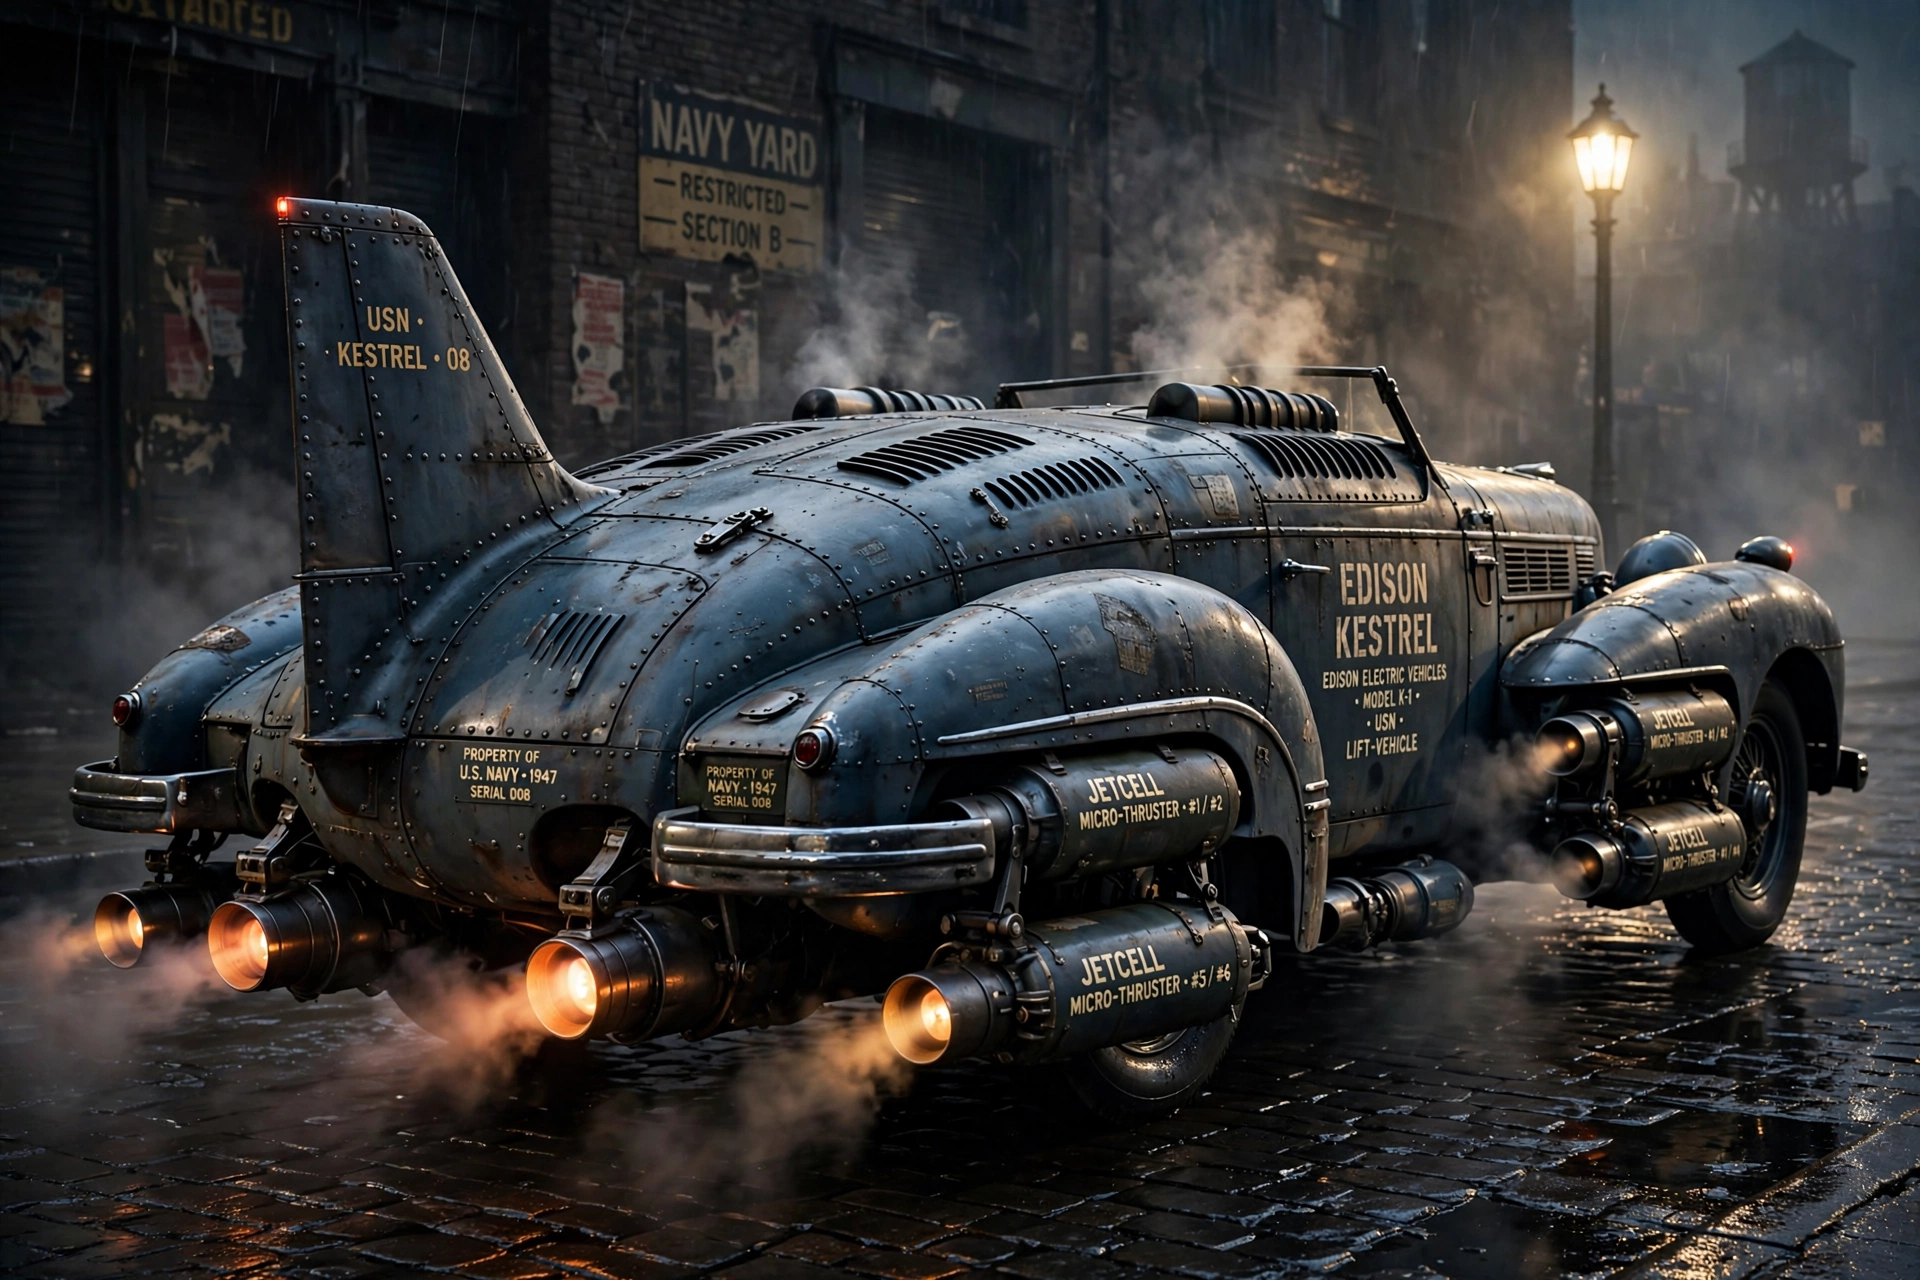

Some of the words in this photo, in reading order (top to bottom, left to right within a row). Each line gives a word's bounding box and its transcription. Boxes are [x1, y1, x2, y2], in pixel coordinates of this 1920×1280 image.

[651, 99, 735, 163] NAVY
[744, 119, 817, 179] YARD
[680, 171, 786, 216] RESTRICTED
[682, 211, 761, 250] SECTION
[769, 225, 782, 253] B
[367, 306, 410, 333] USN
[337, 341, 427, 370] KESTREL
[446, 347, 471, 372] 08
[1339, 562, 1428, 606] EDISON
[1336, 612, 1438, 659] KESTREL
[1322, 670, 1359, 690] EDISON
[1362, 667, 1405, 687] ELECTRIC
[1407, 664, 1448, 682] VEHICLES
[1363, 690, 1396, 709] MODEL
[1375, 712, 1396, 732] USN
[1651, 707, 1695, 730] JETCELL
[463, 747, 521, 763] PROPERTY
[525, 750, 540, 763] OF
[1346, 733, 1418, 760] LIFT-VEHICLE
[460, 764, 483, 780] U.S.
[486, 765, 519, 783] NAVY
[530, 768, 557, 784] 1947
[706, 765, 757, 780] PROPERTY
[761, 768, 774, 780] OF
[470, 785, 506, 800] SERIAL
[509, 787, 531, 801] 008
[708, 778, 740, 794] NAVY
[750, 781, 777, 796] 1947
[1086, 772, 1165, 804] JETCELL
[713, 794, 749, 808] SERIAL
[751, 796, 772, 809] 008
[1079, 800, 1180, 831] MICRO-THRUSTER
[1666, 826, 1709, 852] JETCELL
[1081, 945, 1166, 987] JETCELL
[1070, 974, 1181, 1017] MICRO-THRUSTER
